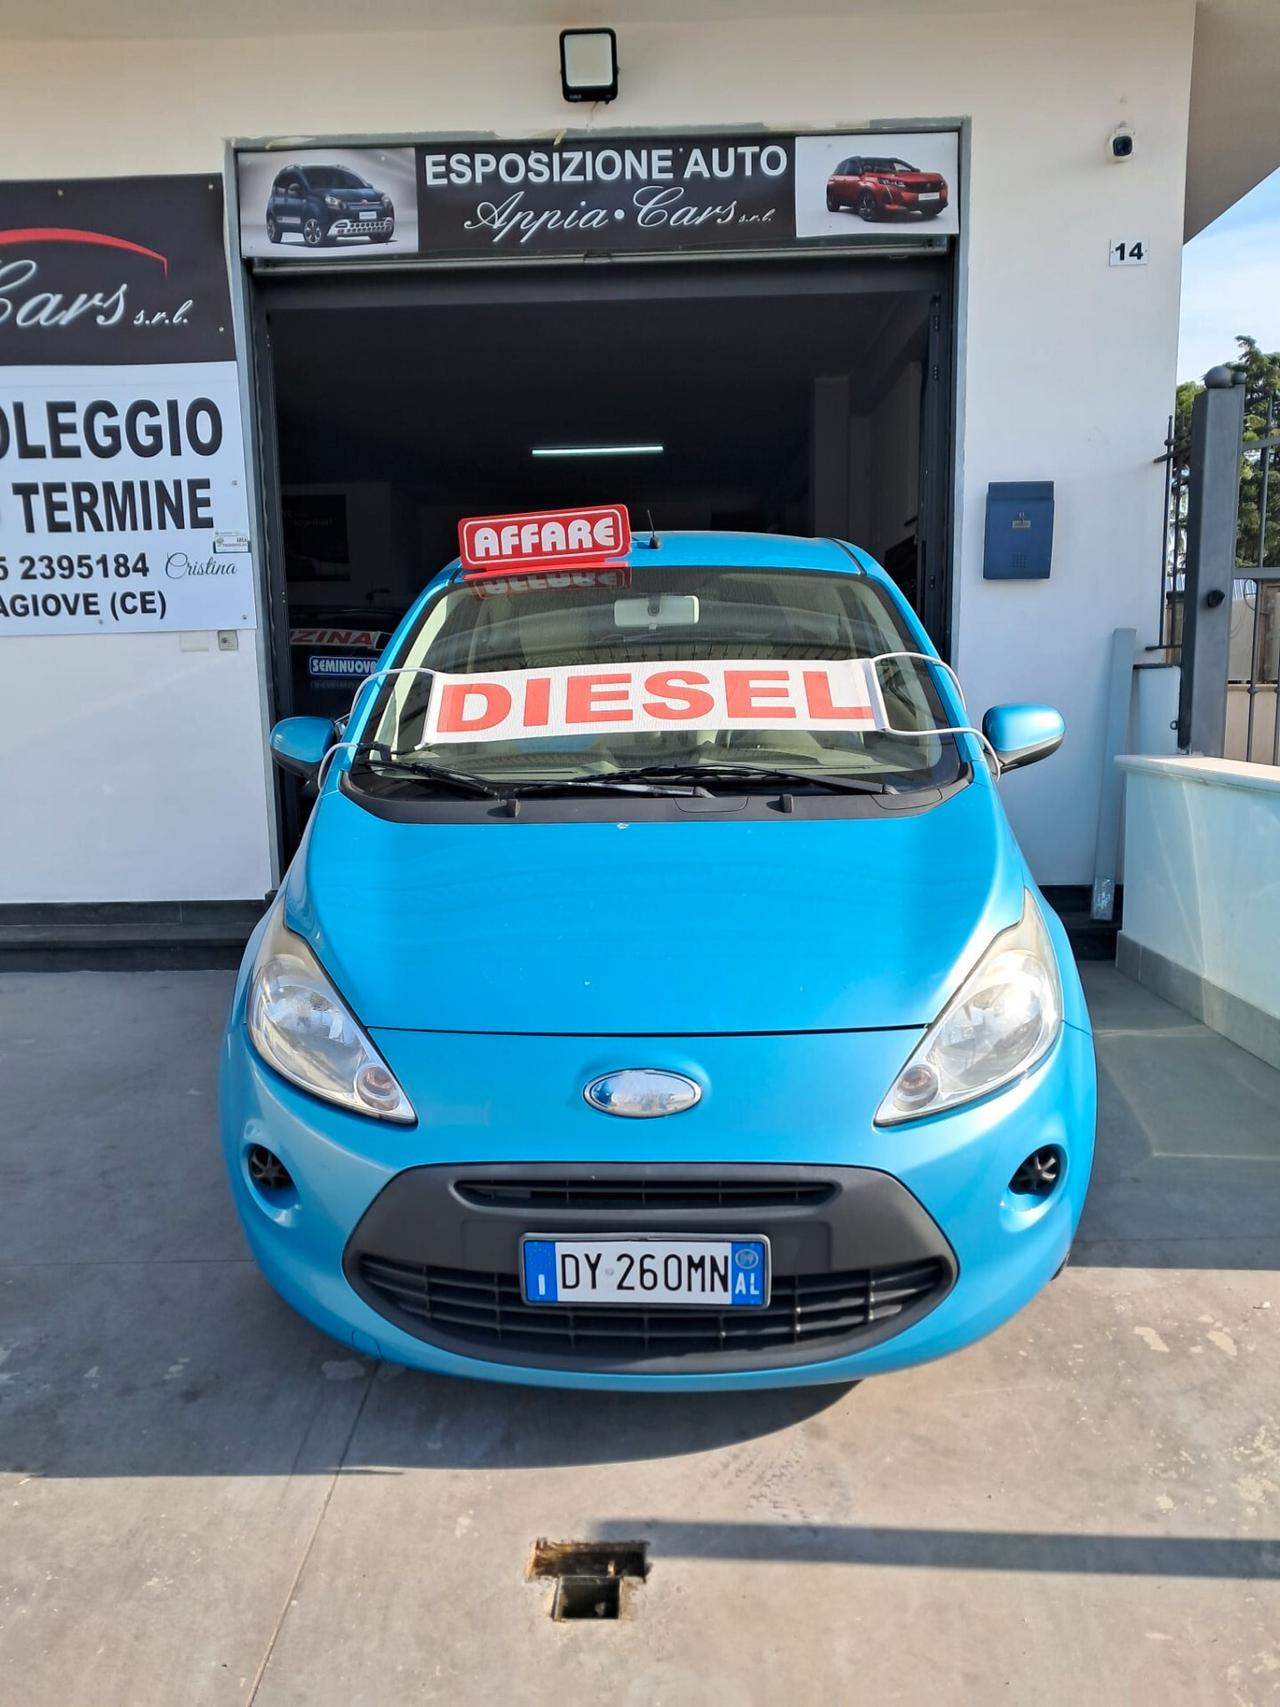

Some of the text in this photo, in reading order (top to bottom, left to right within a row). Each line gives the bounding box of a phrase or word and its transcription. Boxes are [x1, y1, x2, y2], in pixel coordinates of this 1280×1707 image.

[425, 145, 788, 185] ESPOSIZIONE AUTO
[463, 190, 610, 243] Appia
[632, 185, 738, 228] Cars
[1114, 242, 1144, 261] 14
[133, 299, 194, 325] s.r.l.
[0, 397, 223, 459] LEGGIO
[12, 477, 215, 533] TERMINE
[473, 516, 616, 558] AFFARE
[18, 552, 150, 581] 2395184
[164, 551, 238, 580] Cristina
[110, 590, 167, 621] (CE)
[436, 670, 875, 733] DIESEL
[560, 1253, 602, 1290] DY
[616, 1253, 729, 1292] 260MN
[734, 1271, 760, 1295] AL
